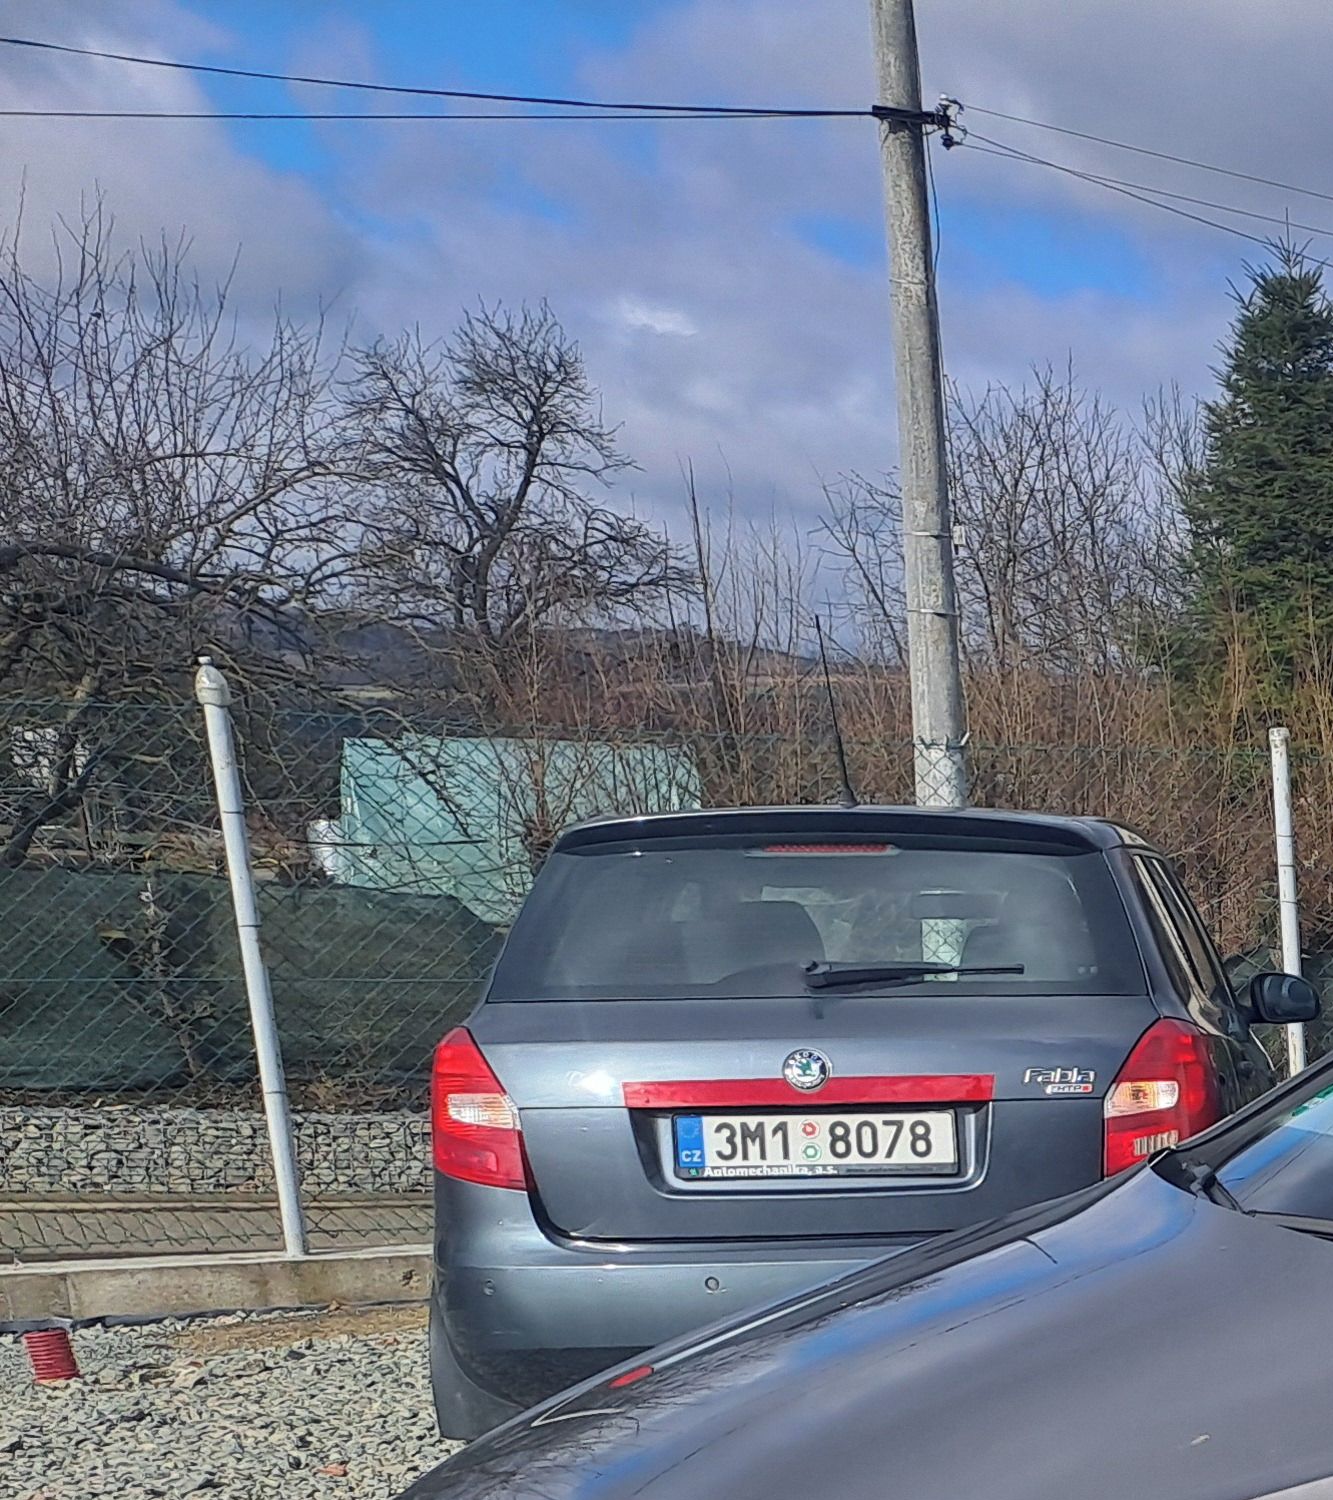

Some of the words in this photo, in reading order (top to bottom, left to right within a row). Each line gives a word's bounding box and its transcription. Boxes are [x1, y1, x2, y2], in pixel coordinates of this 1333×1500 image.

[714, 1121, 790, 1161] 3M1
[828, 1119, 933, 1159] 8078
[681, 1150, 702, 1162] CZ
